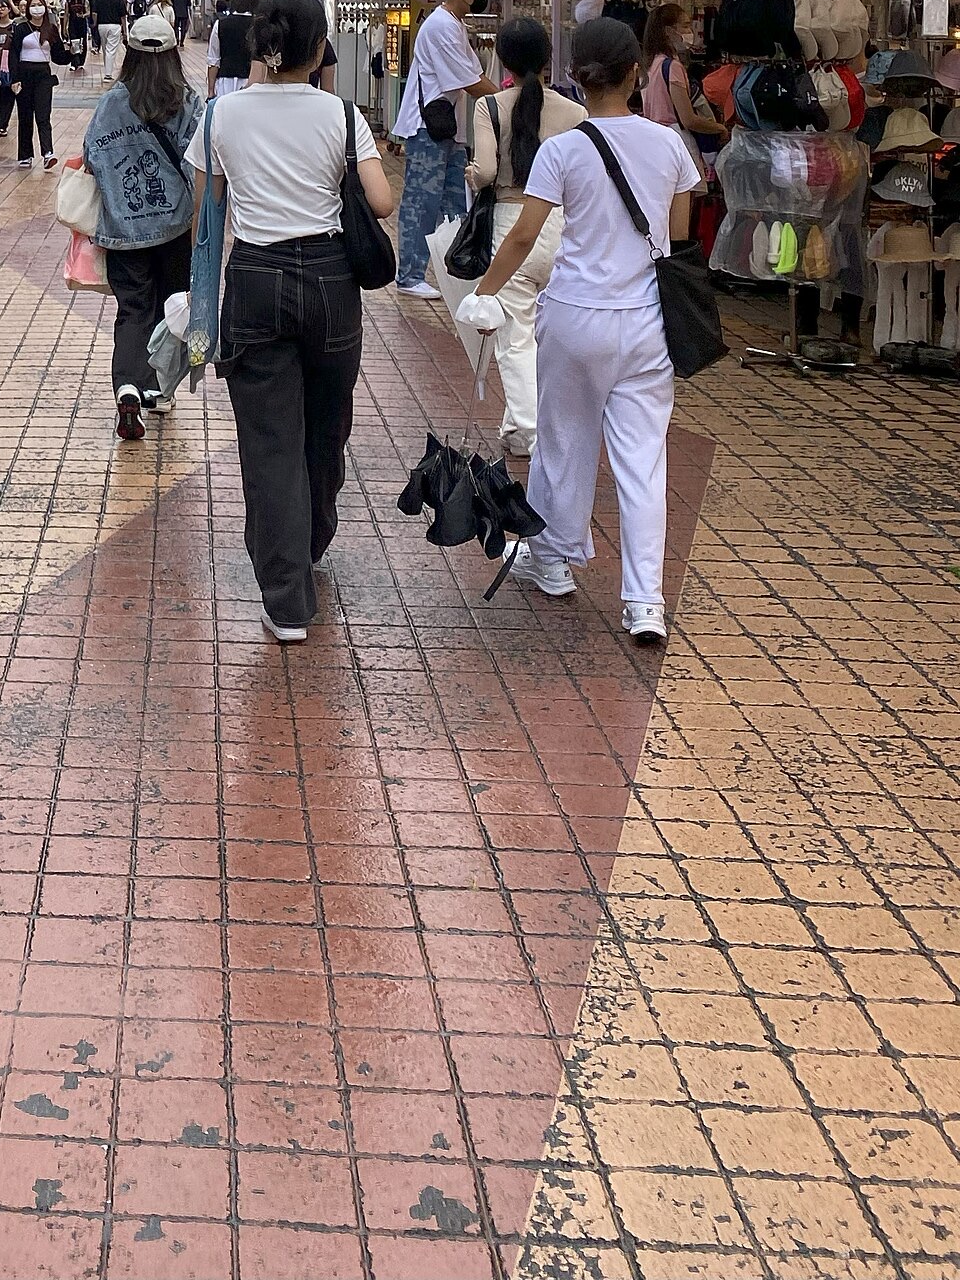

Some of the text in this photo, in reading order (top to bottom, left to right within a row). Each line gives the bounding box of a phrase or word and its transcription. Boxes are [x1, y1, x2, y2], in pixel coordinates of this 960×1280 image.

[95, 128, 125, 148] DENIM
[894, 176, 924, 192] BKLYN
[901, 184, 916, 193] NY
